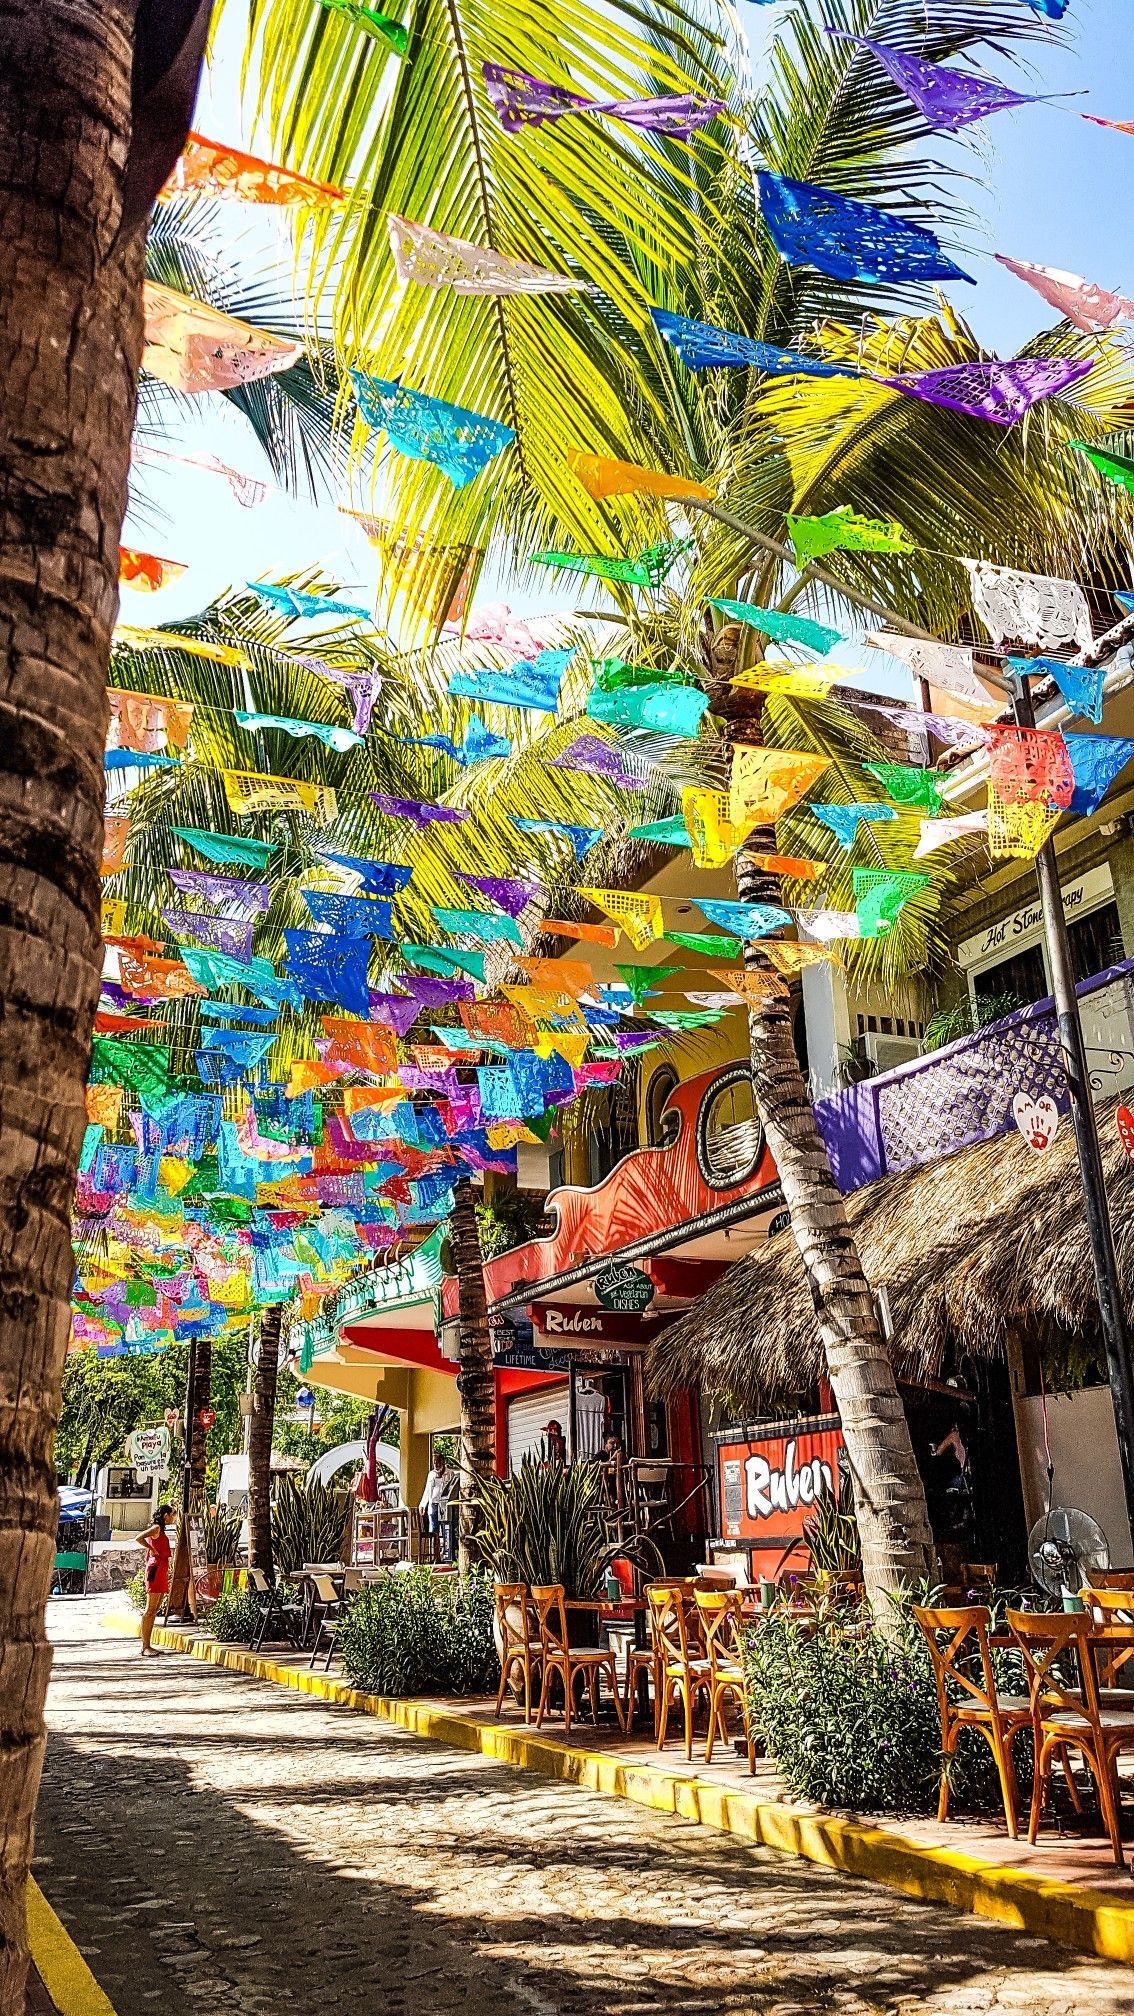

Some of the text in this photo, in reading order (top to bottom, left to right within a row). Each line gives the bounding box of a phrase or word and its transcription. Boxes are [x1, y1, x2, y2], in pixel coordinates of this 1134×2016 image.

[982, 921, 1010, 952] Hot
[1012, 908, 1043, 934] Stone
[596, 1267, 636, 1289] Ruben
[613, 1299, 640, 1310] DISHES
[546, 1310, 603, 1332] Ruben
[505, 1354, 536, 1366] LIFETIME
[744, 1440, 834, 1520] Ruben
